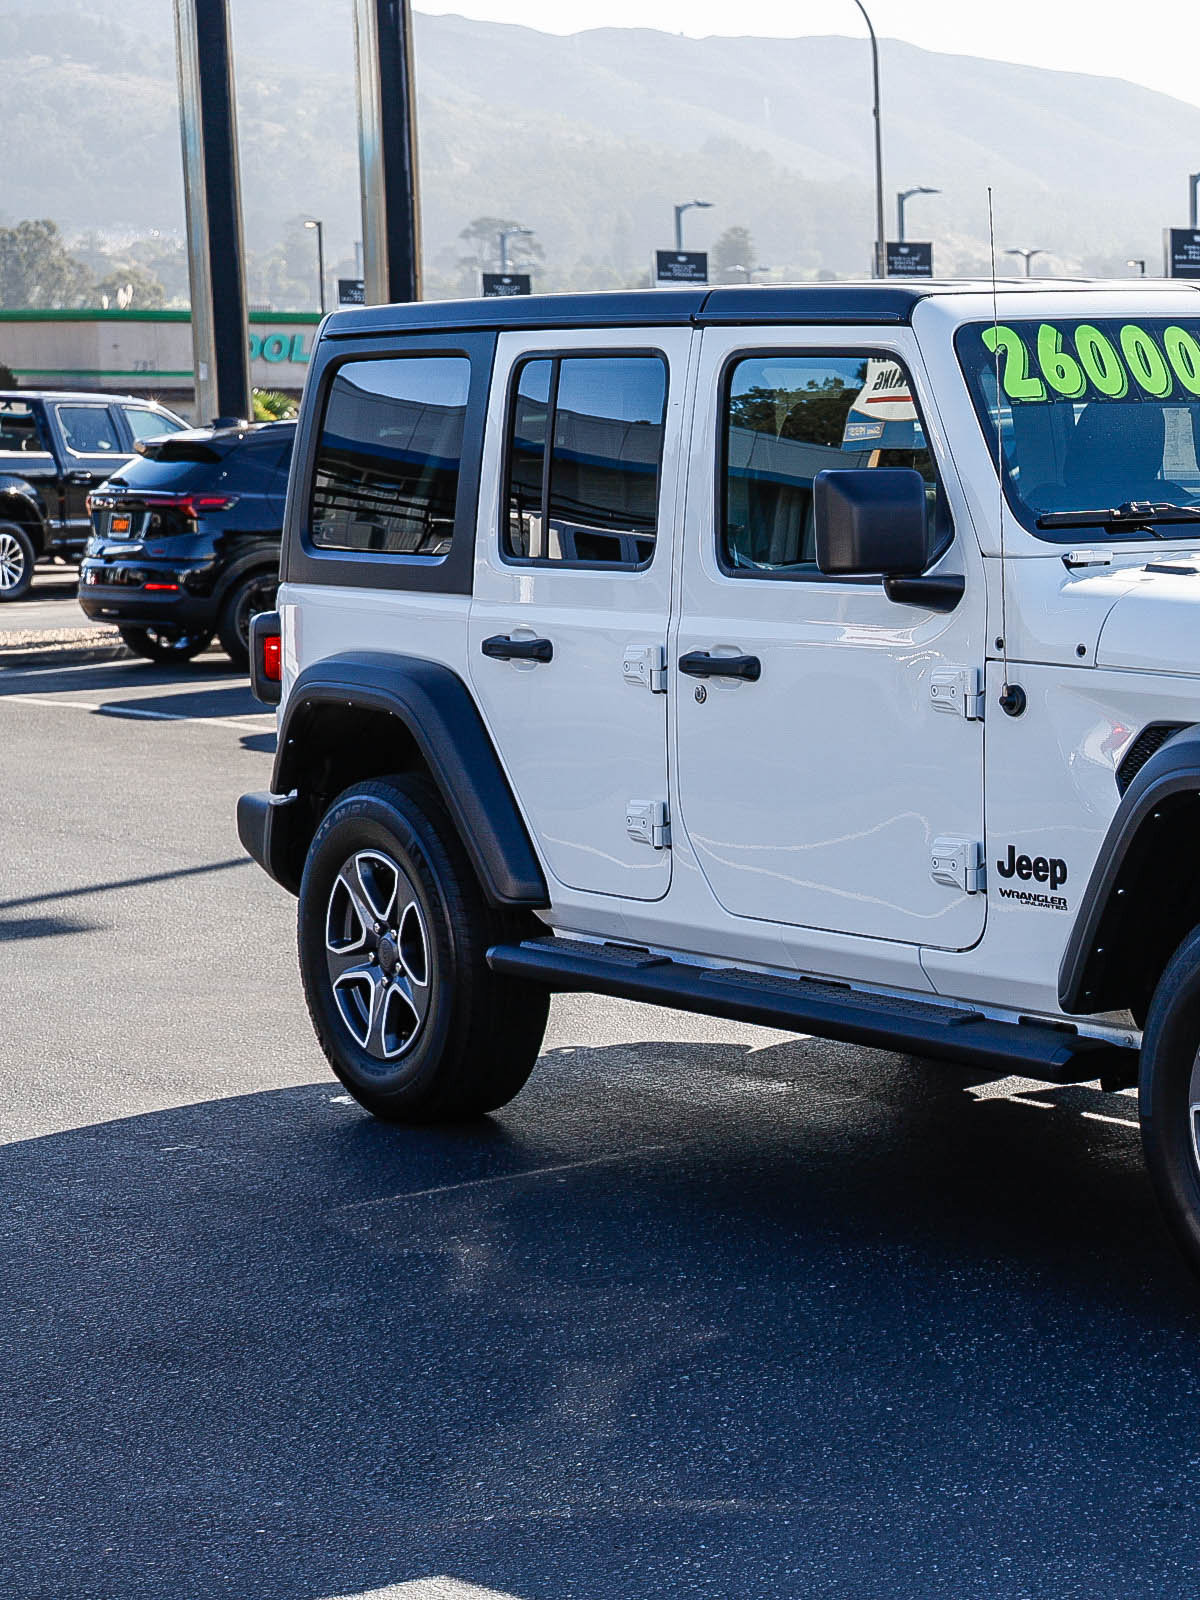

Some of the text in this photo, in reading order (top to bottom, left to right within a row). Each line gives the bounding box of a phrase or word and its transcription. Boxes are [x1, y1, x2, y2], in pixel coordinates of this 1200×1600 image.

[997, 844, 1068, 890] Jeep
[998, 887, 1068, 907] WRANGLER
[1020, 900, 1068, 911] UNLIMITED
